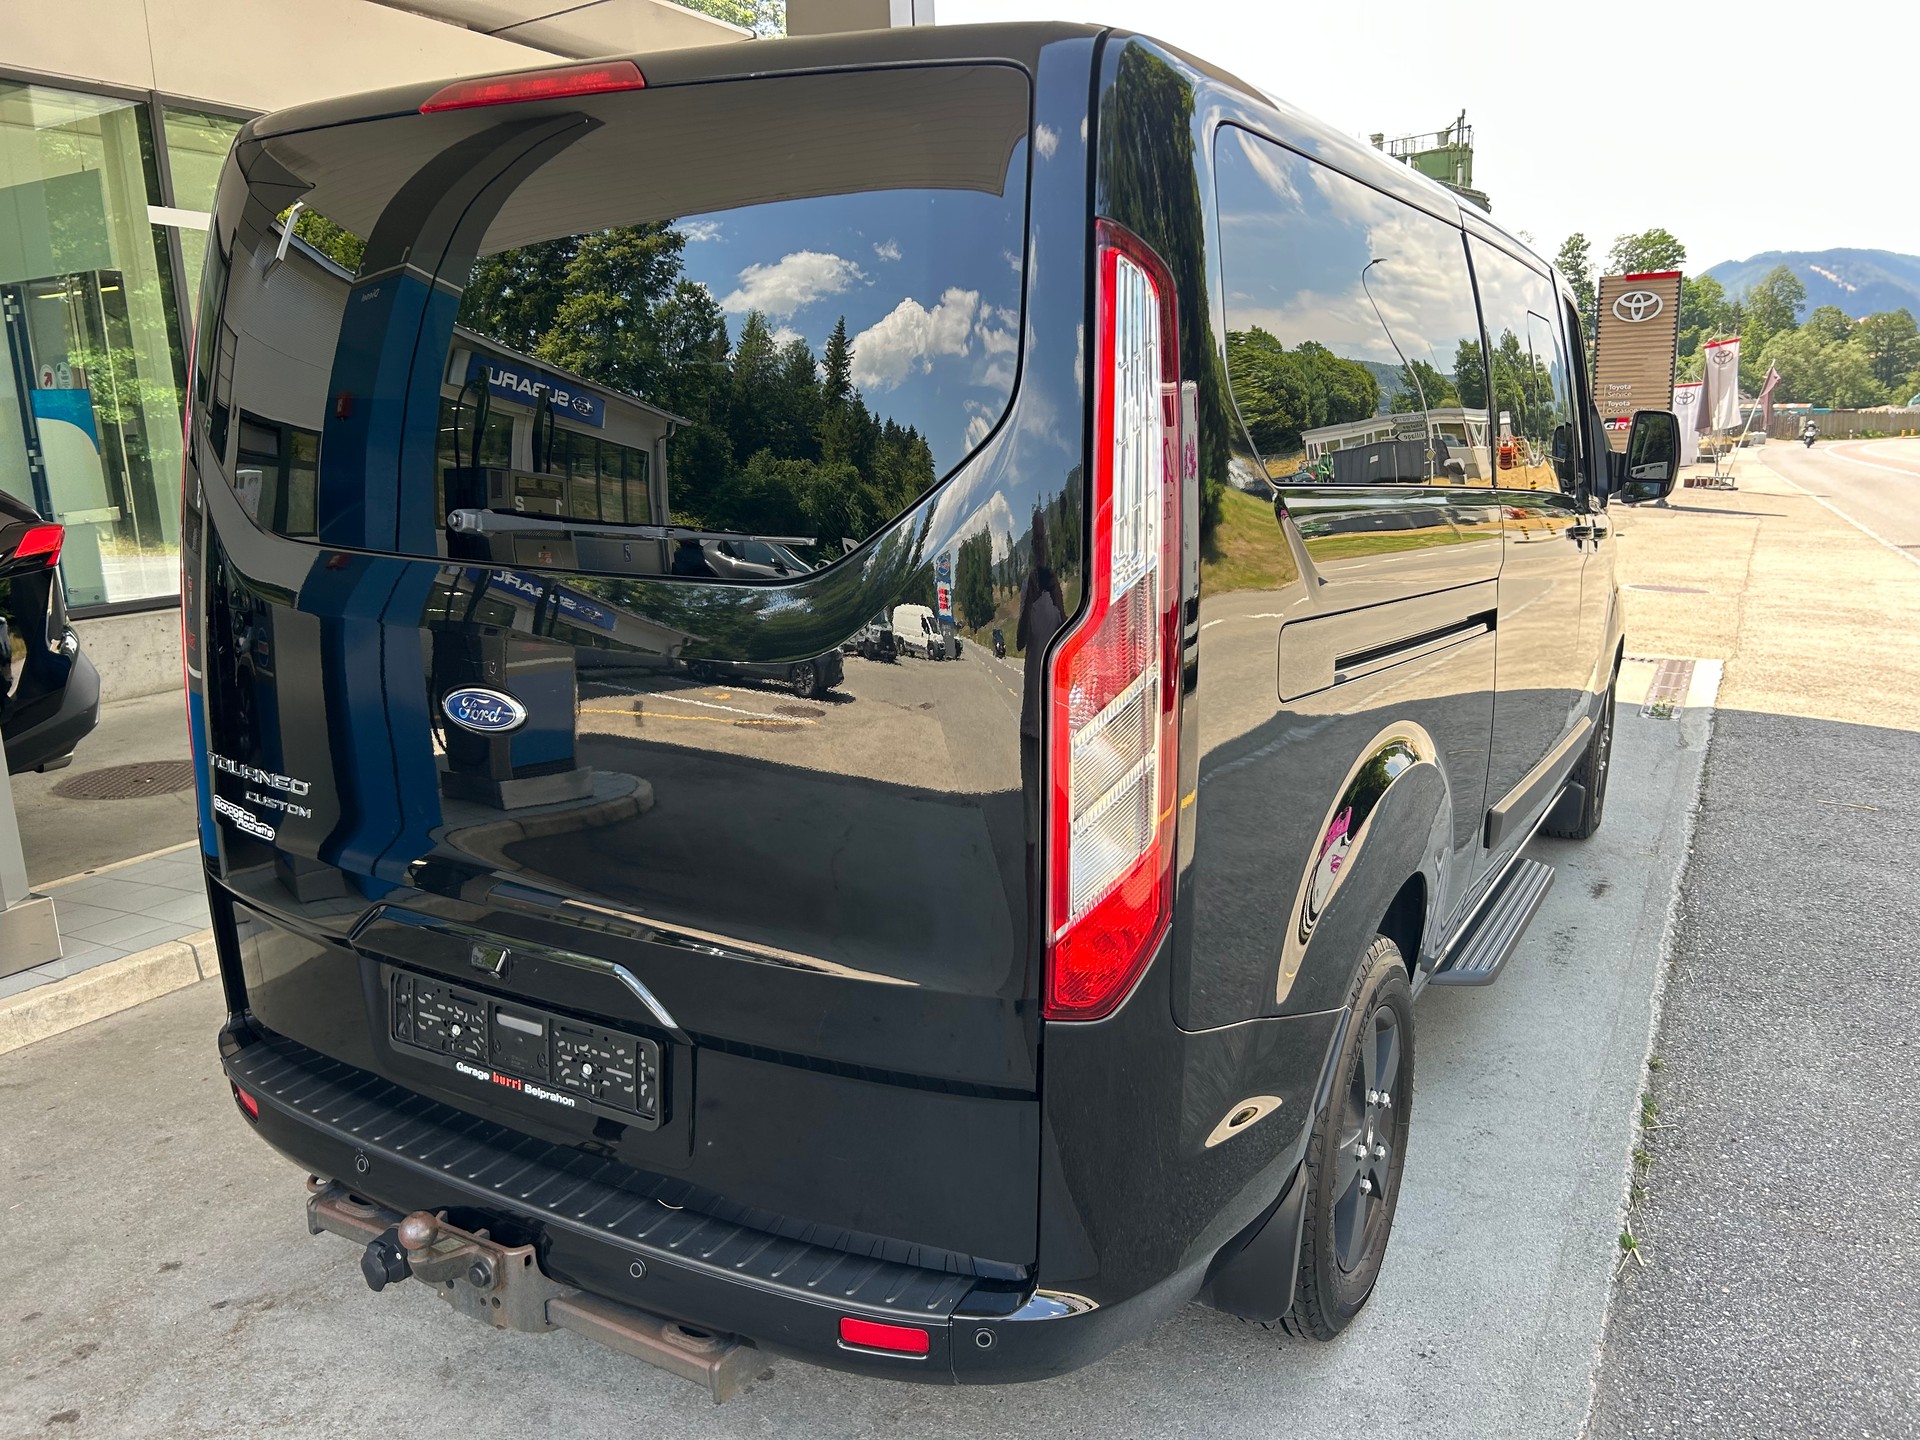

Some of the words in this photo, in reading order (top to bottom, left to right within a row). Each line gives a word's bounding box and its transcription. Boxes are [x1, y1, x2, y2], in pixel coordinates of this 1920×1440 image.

[458, 696, 502, 723] Ford
[207, 751, 310, 796] TOURNEO
[214, 798, 244, 818] Garage
[245, 791, 312, 818] CUSTOM
[238, 818, 273, 837] Rochette
[456, 1061, 490, 1080] Garage
[492, 1072, 522, 1090] burri
[524, 1084, 575, 1107] Belprahon
